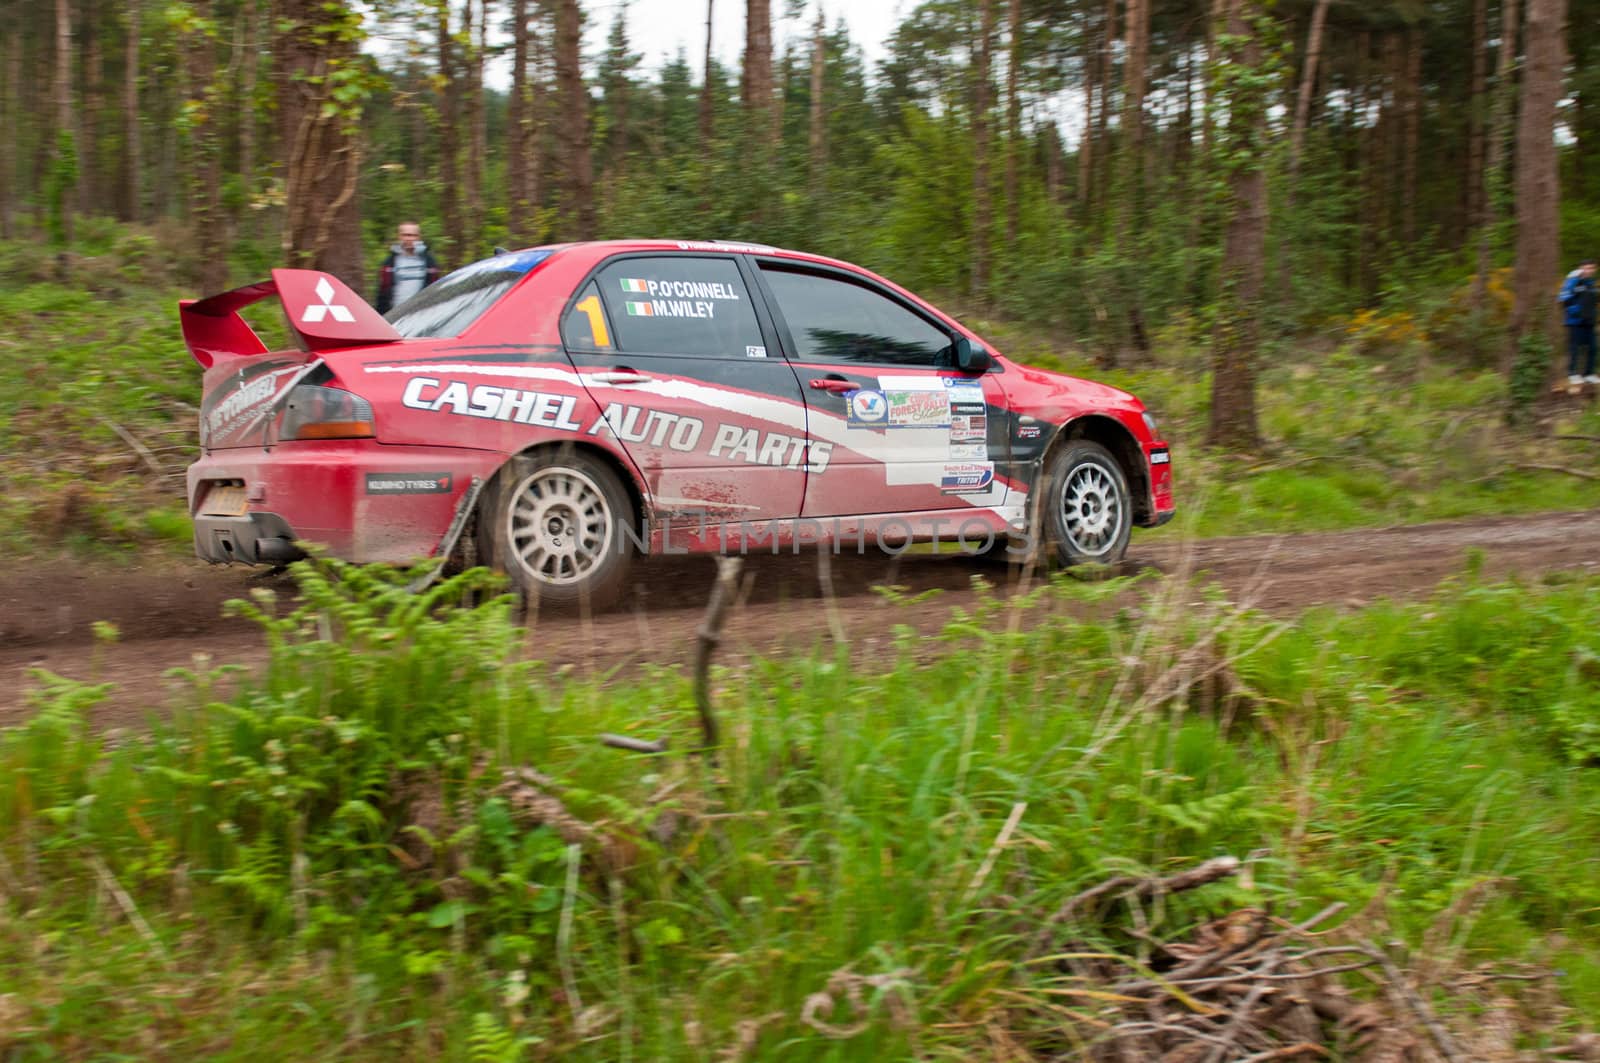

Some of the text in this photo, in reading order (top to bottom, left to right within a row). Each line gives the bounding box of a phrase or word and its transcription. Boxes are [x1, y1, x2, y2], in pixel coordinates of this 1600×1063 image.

[647, 280, 739, 300] P.O'CONNELL
[653, 300, 715, 319] M.WILEY
[576, 296, 611, 348] 1
[890, 401, 922, 418] FOREST
[923, 398, 948, 410] RALLY
[402, 376, 834, 475] CASHEL AUTO PARTS
[405, 480, 437, 489] TYRES
